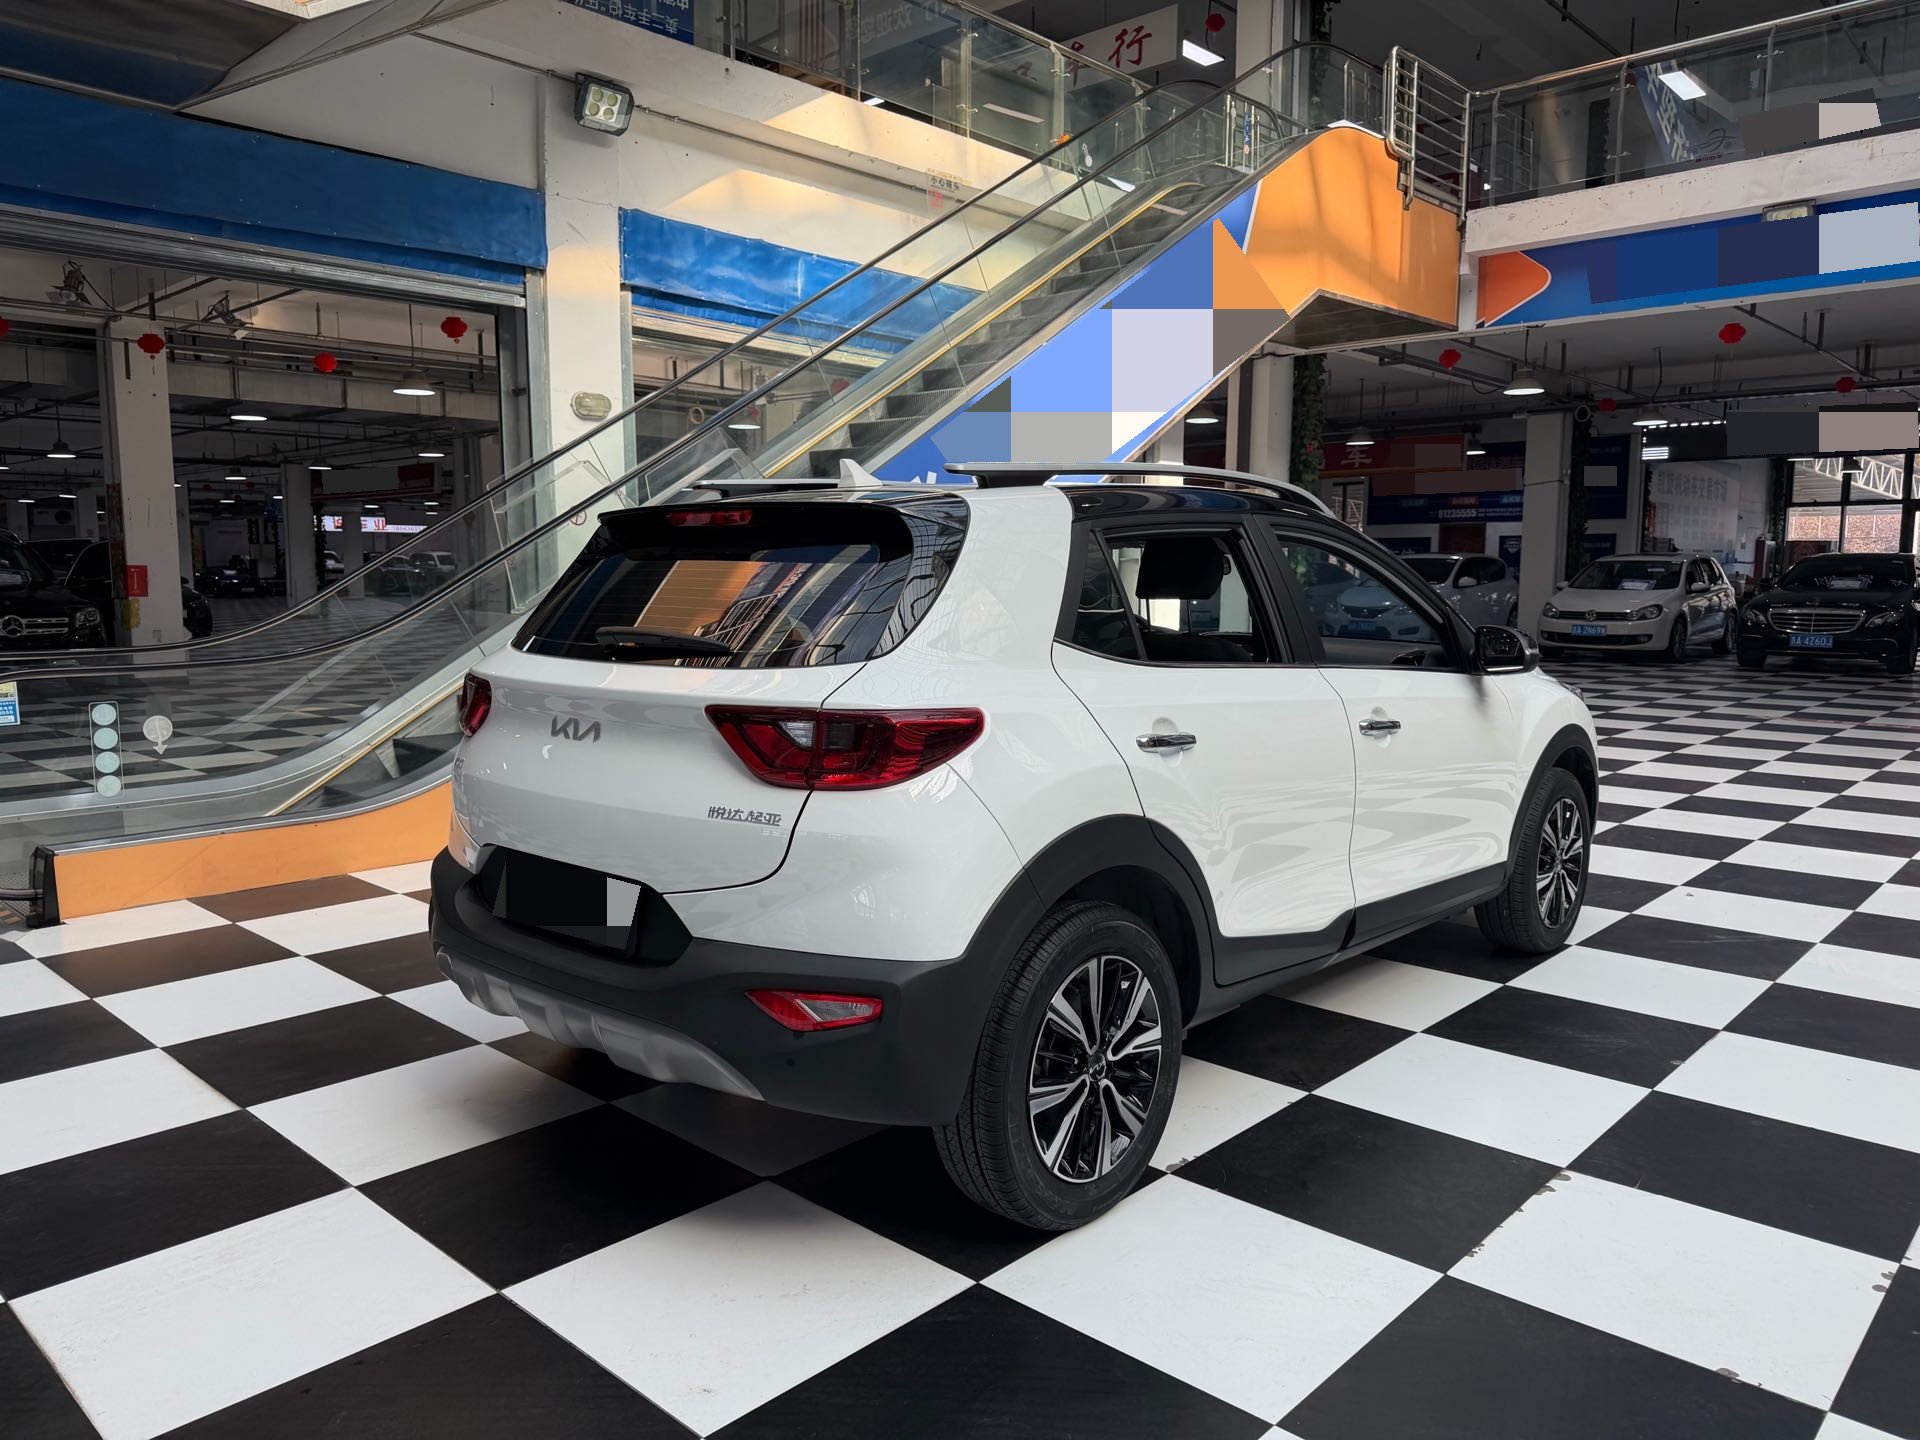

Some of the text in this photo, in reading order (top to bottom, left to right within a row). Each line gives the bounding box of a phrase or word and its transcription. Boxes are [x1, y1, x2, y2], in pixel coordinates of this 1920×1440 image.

[551, 715, 601, 744] KIA
[707, 805, 782, 827] 悦达起亚
